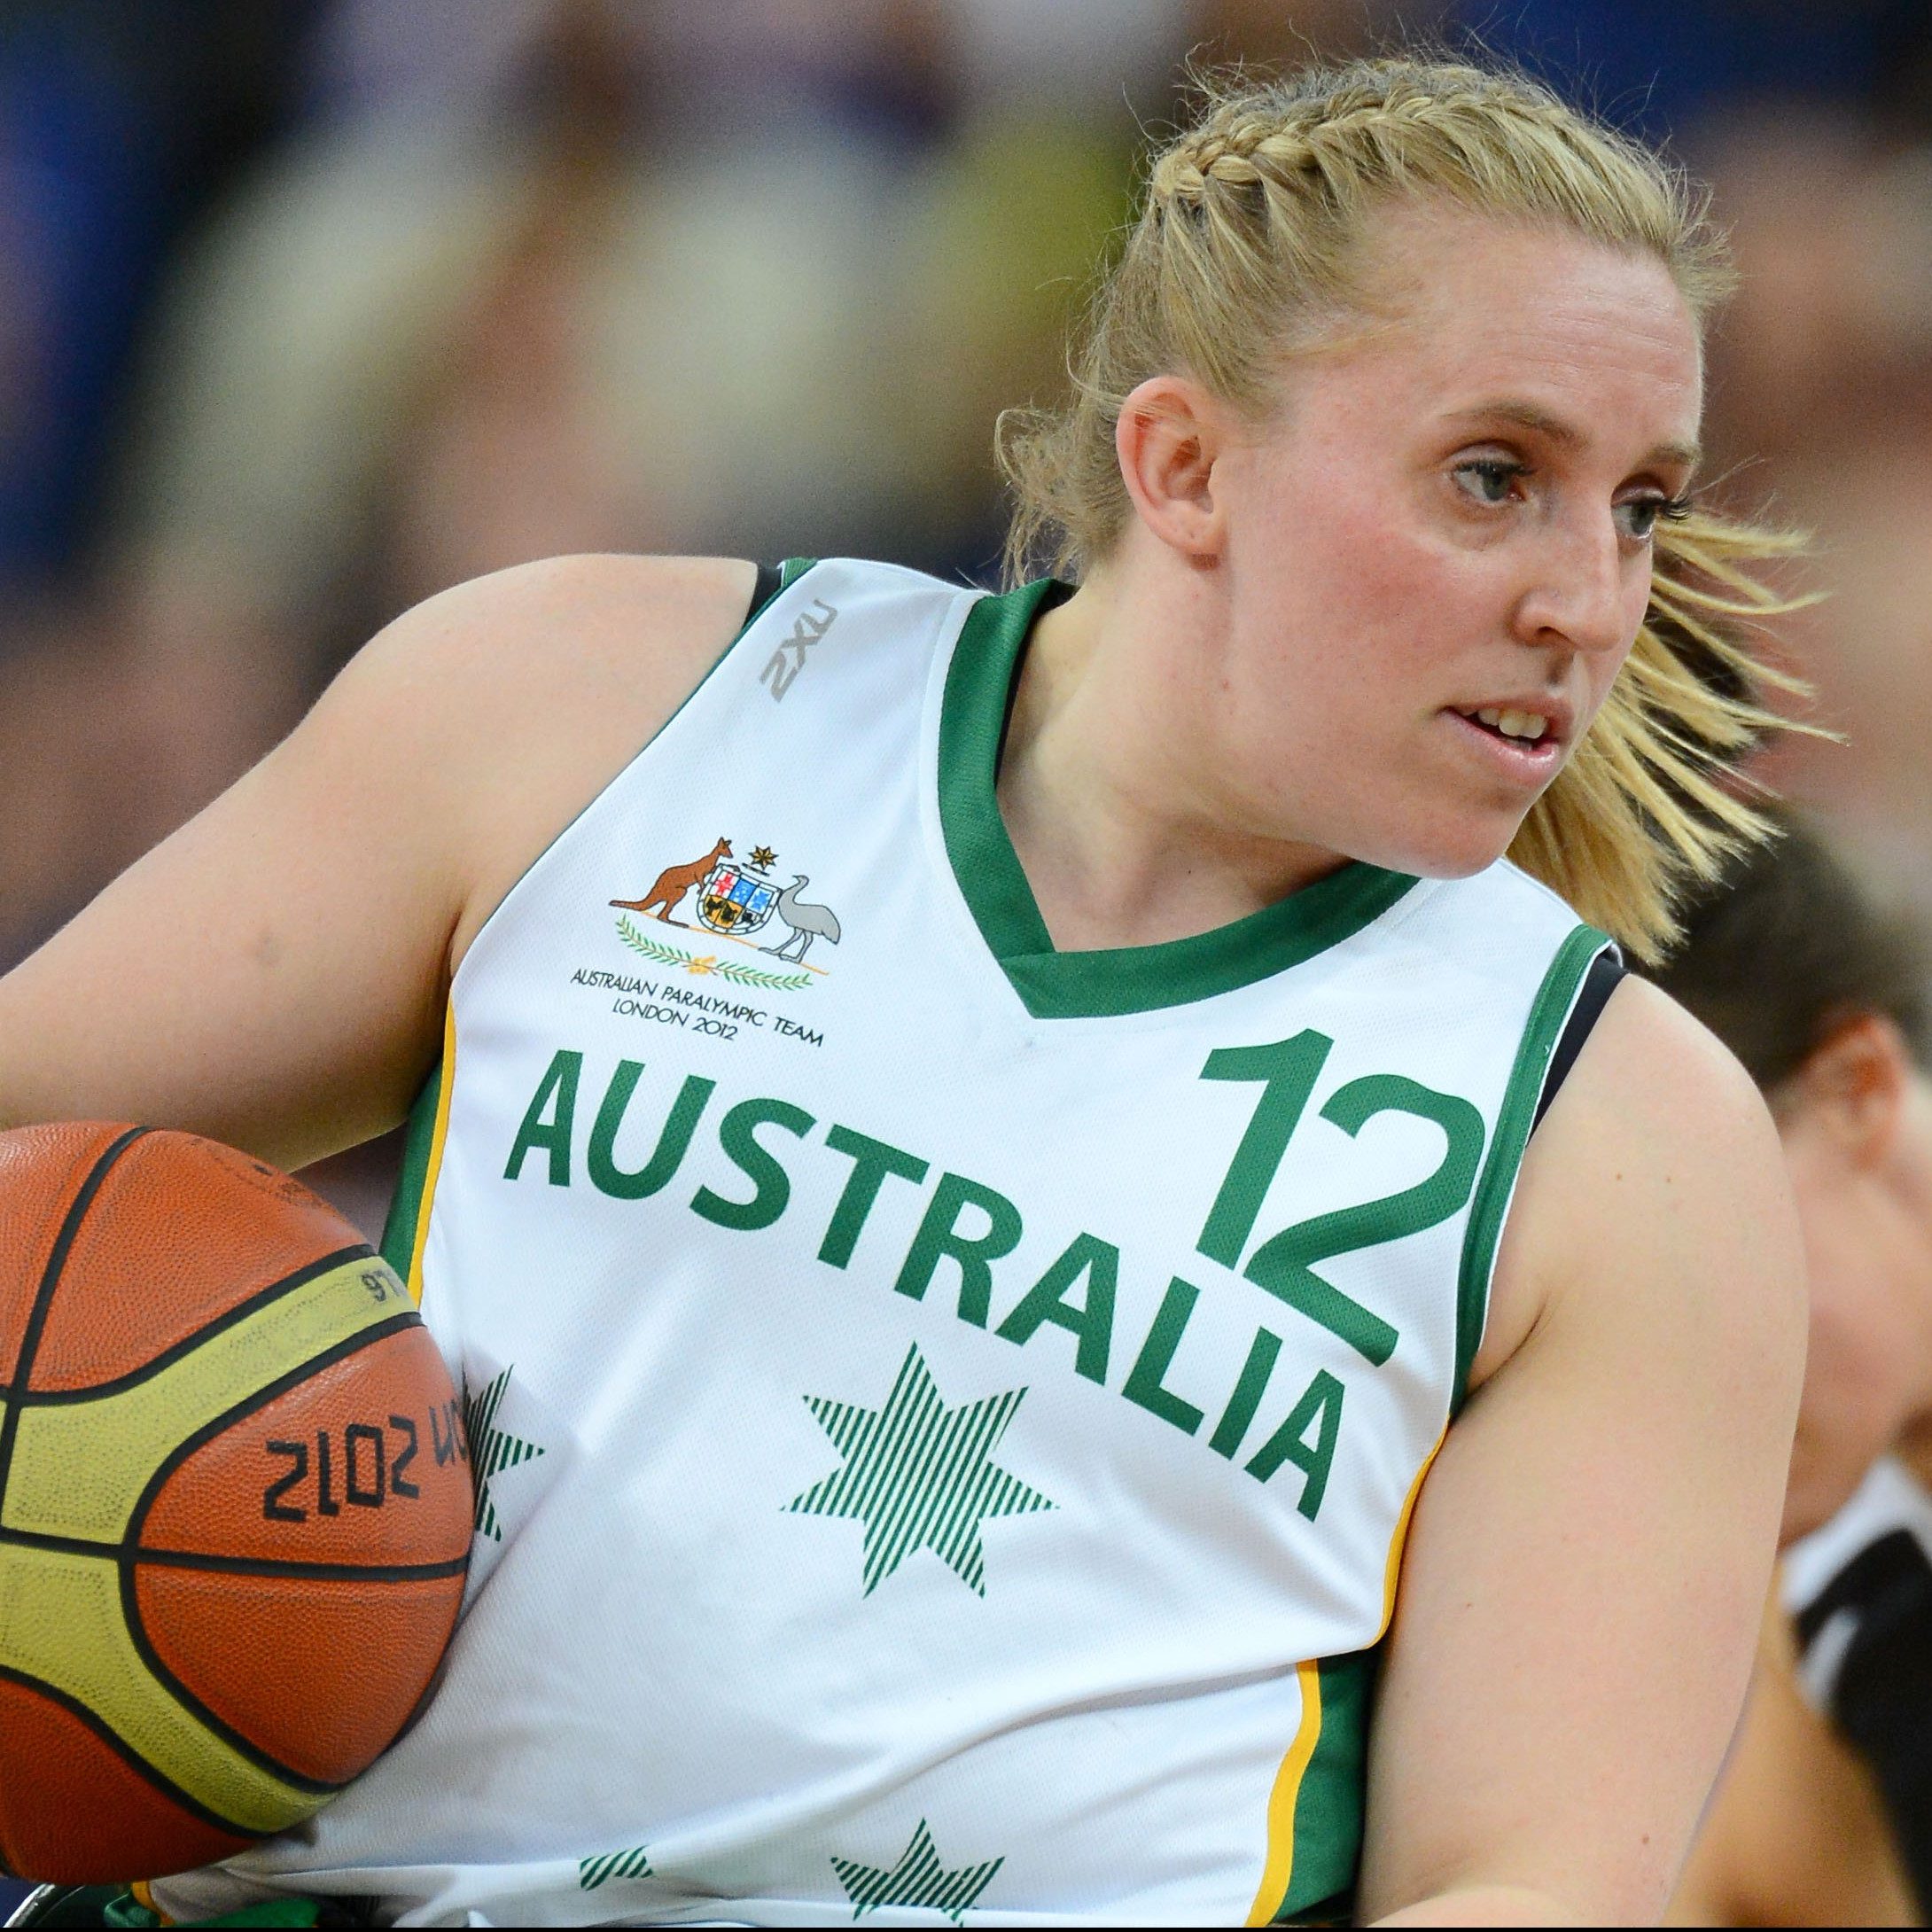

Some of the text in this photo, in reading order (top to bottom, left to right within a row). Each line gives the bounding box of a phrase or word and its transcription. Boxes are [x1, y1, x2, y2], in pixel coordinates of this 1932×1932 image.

[759, 598, 838, 703] 2XU
[570, 968, 824, 1048] AUSTRALIAN PARALYMPIC TEAM
[612, 998, 738, 1040] LONDON 2012
[1196, 1027, 1487, 1367] 12
[503, 1049, 1345, 1523] AUSTRALIA
